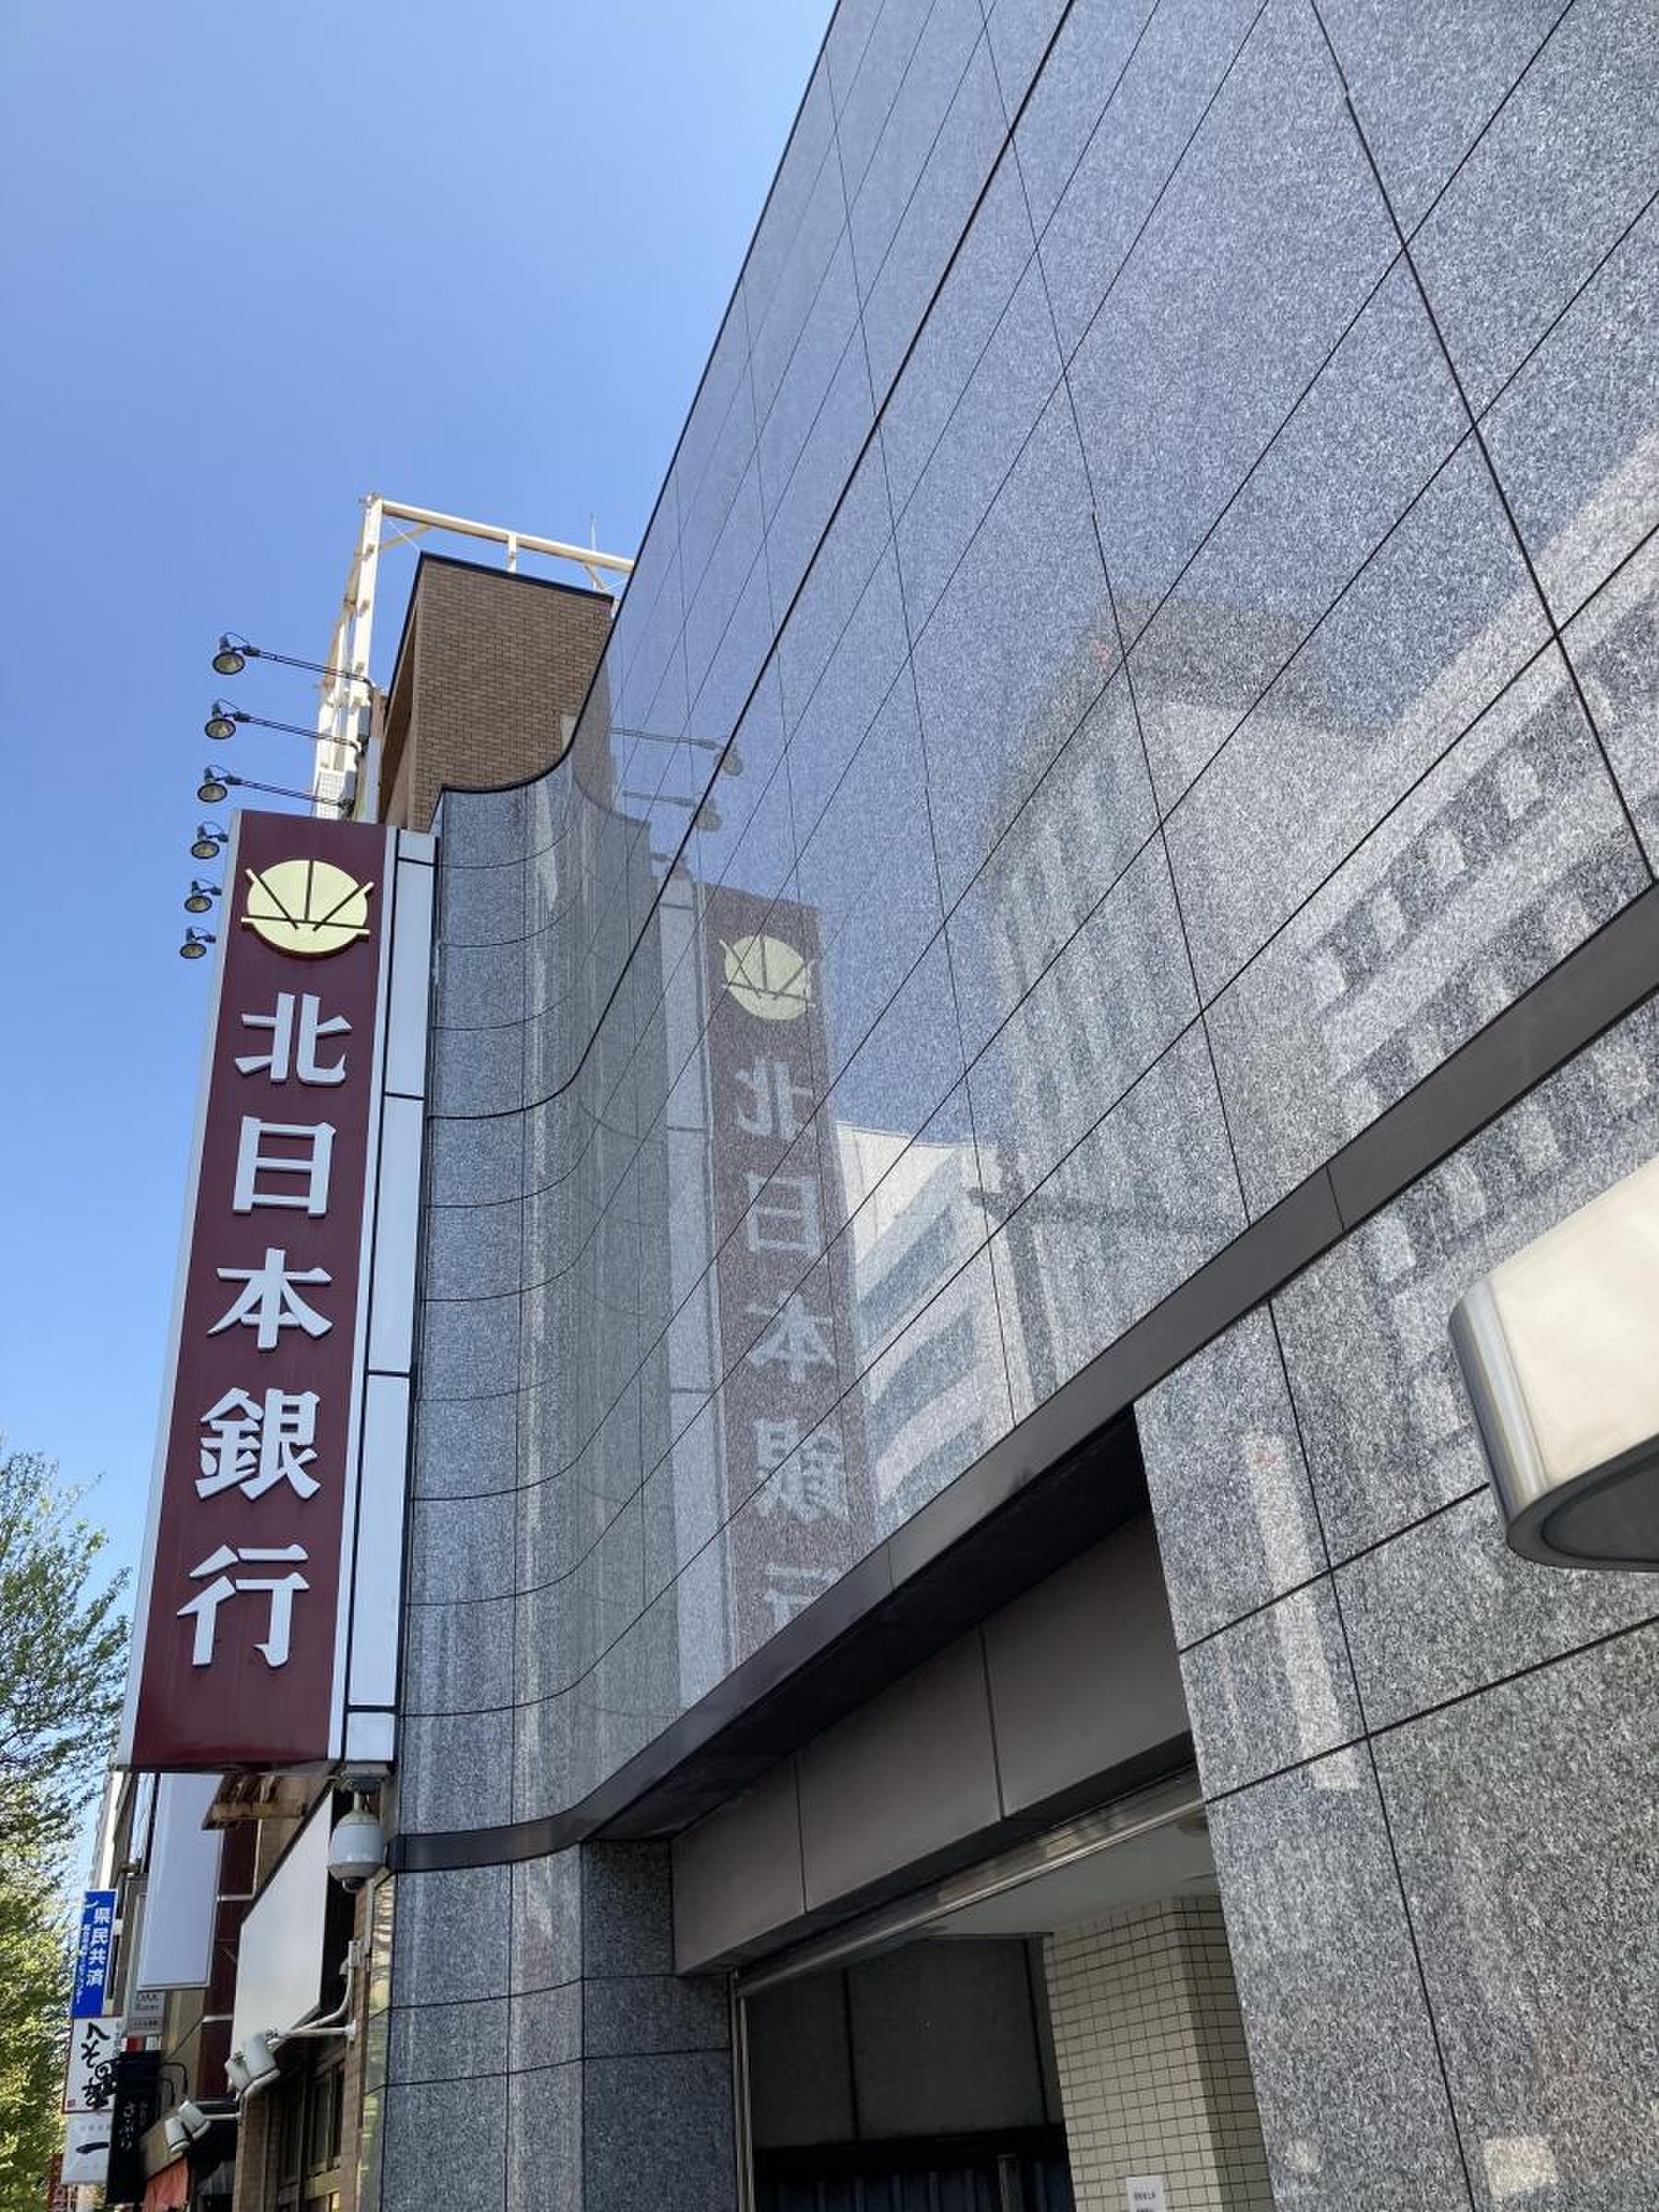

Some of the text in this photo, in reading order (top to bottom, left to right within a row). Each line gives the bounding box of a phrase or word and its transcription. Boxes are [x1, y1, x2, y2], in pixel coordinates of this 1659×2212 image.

[176, 993, 353, 1667] 北日本銀行
